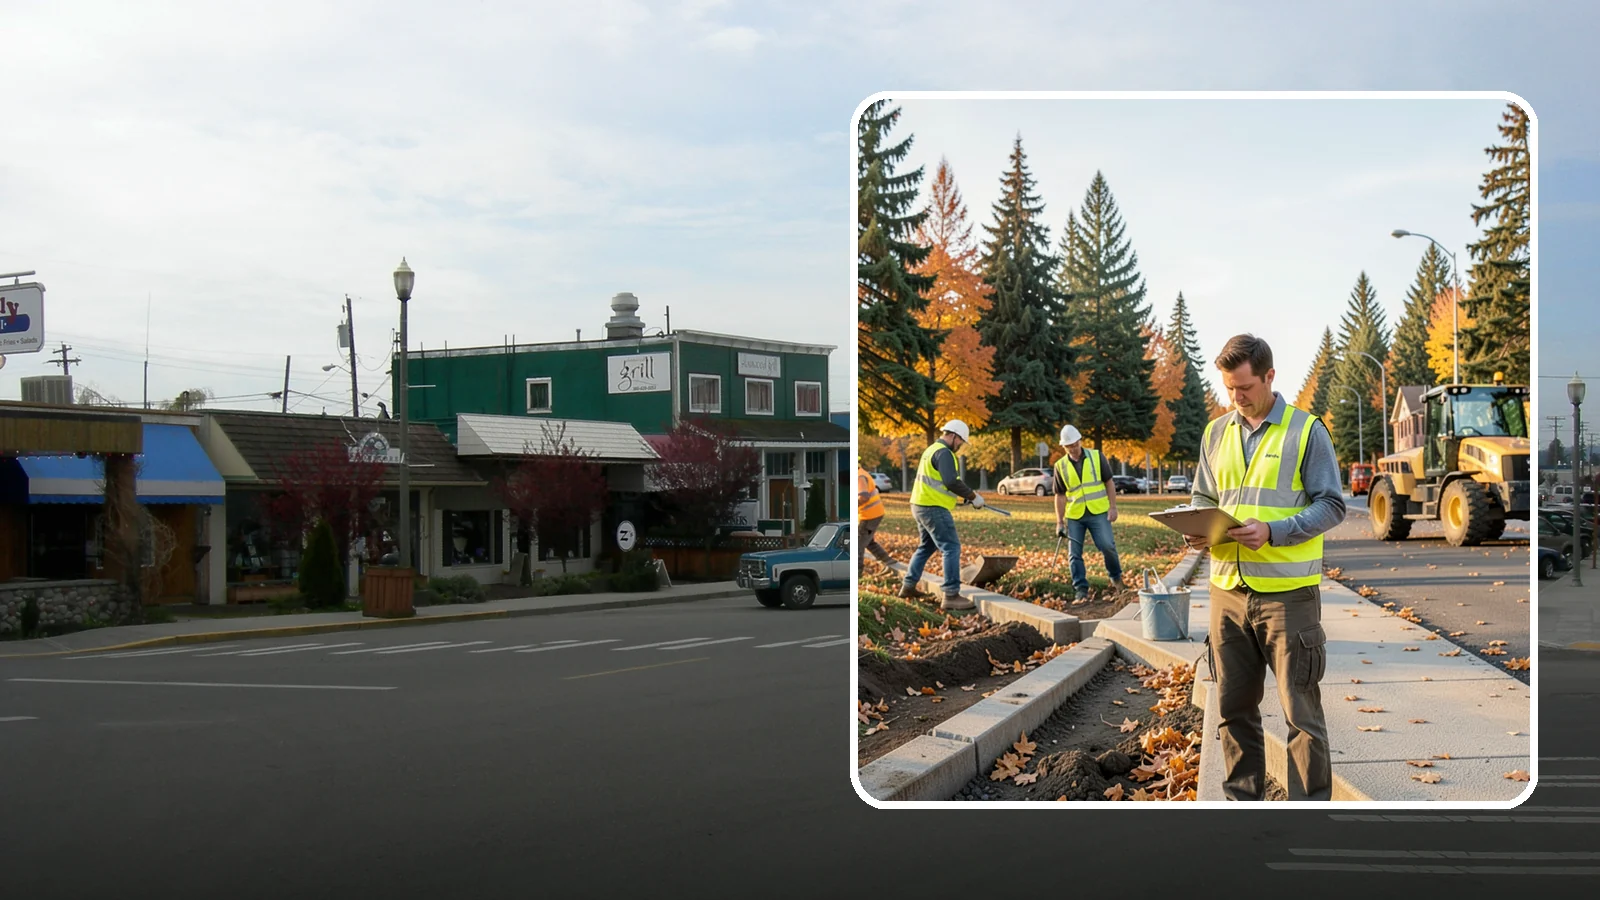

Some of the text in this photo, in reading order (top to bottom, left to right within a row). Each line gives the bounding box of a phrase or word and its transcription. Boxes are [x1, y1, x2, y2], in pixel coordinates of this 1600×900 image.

[0, 297, 19, 324] ly
[20, 336, 38, 345] Salads
[617, 356, 655, 391] grill
